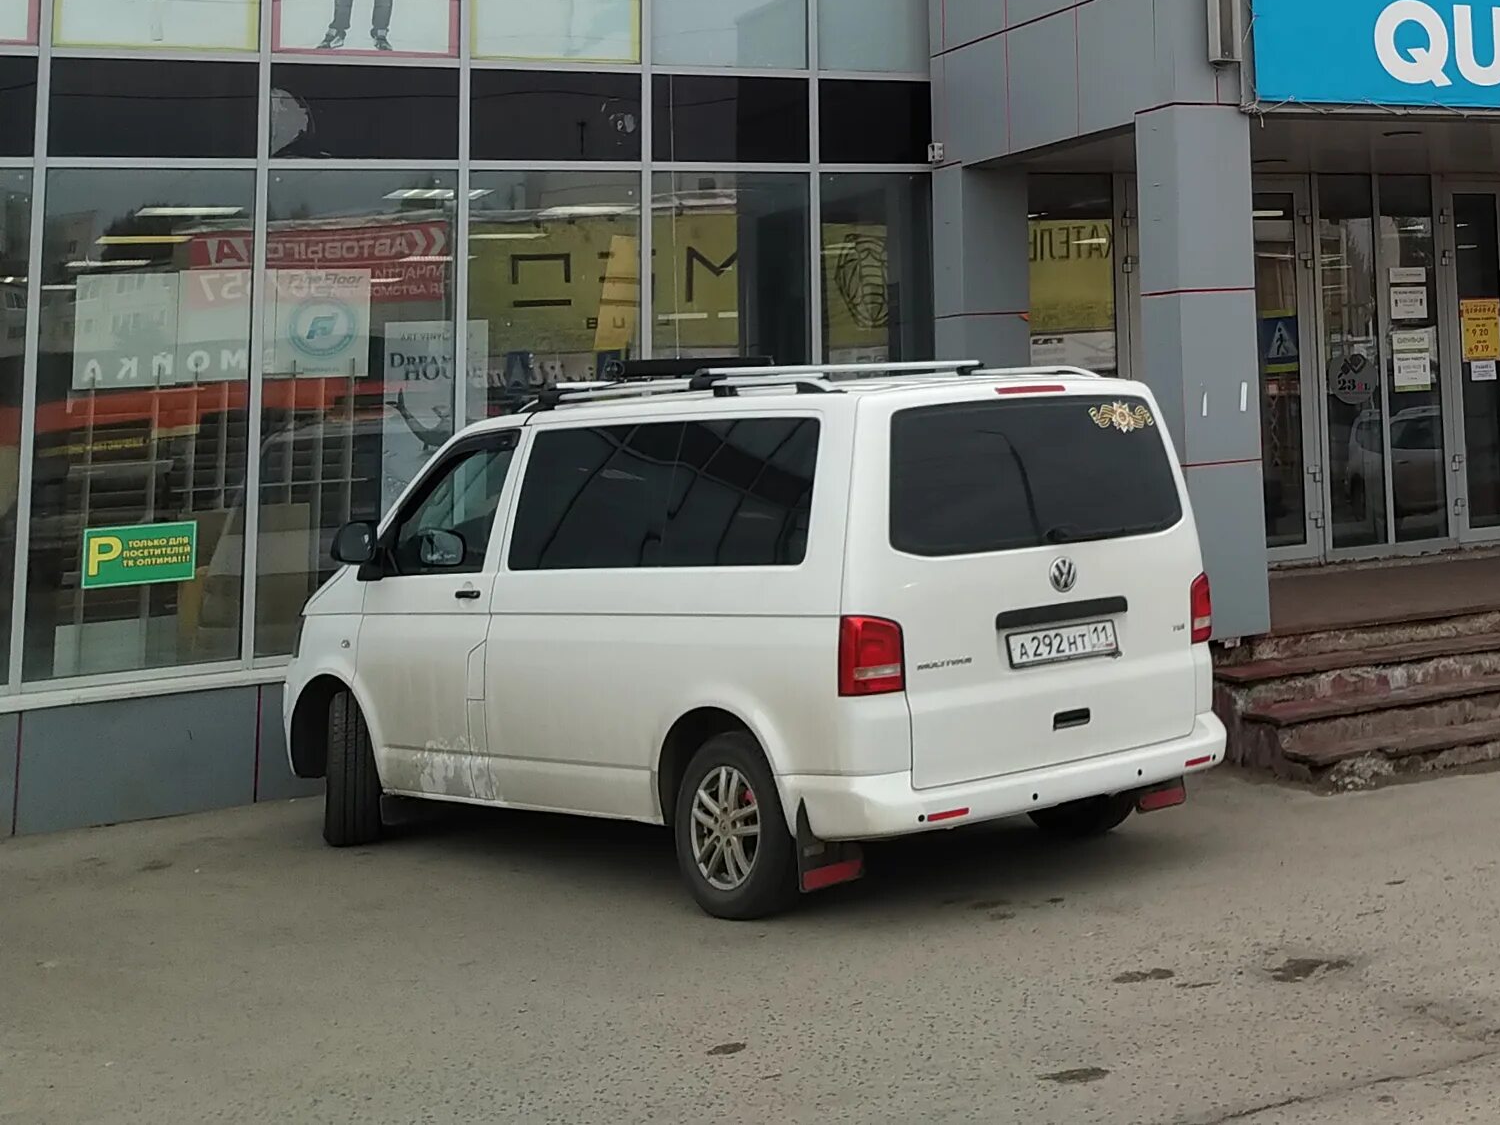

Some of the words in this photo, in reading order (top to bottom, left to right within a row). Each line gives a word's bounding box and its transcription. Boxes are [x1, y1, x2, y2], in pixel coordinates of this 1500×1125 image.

[128, 539, 167, 548] ТОЛЬКО
[168, 536, 189, 546] ДЛЯ
[88, 536, 123, 576] P
[123, 544, 191, 557] ПОСЕТИТЕЛЕЙ
[123, 559, 134, 567] ТК
[136, 555, 190, 566] ОПТИМА!!!
